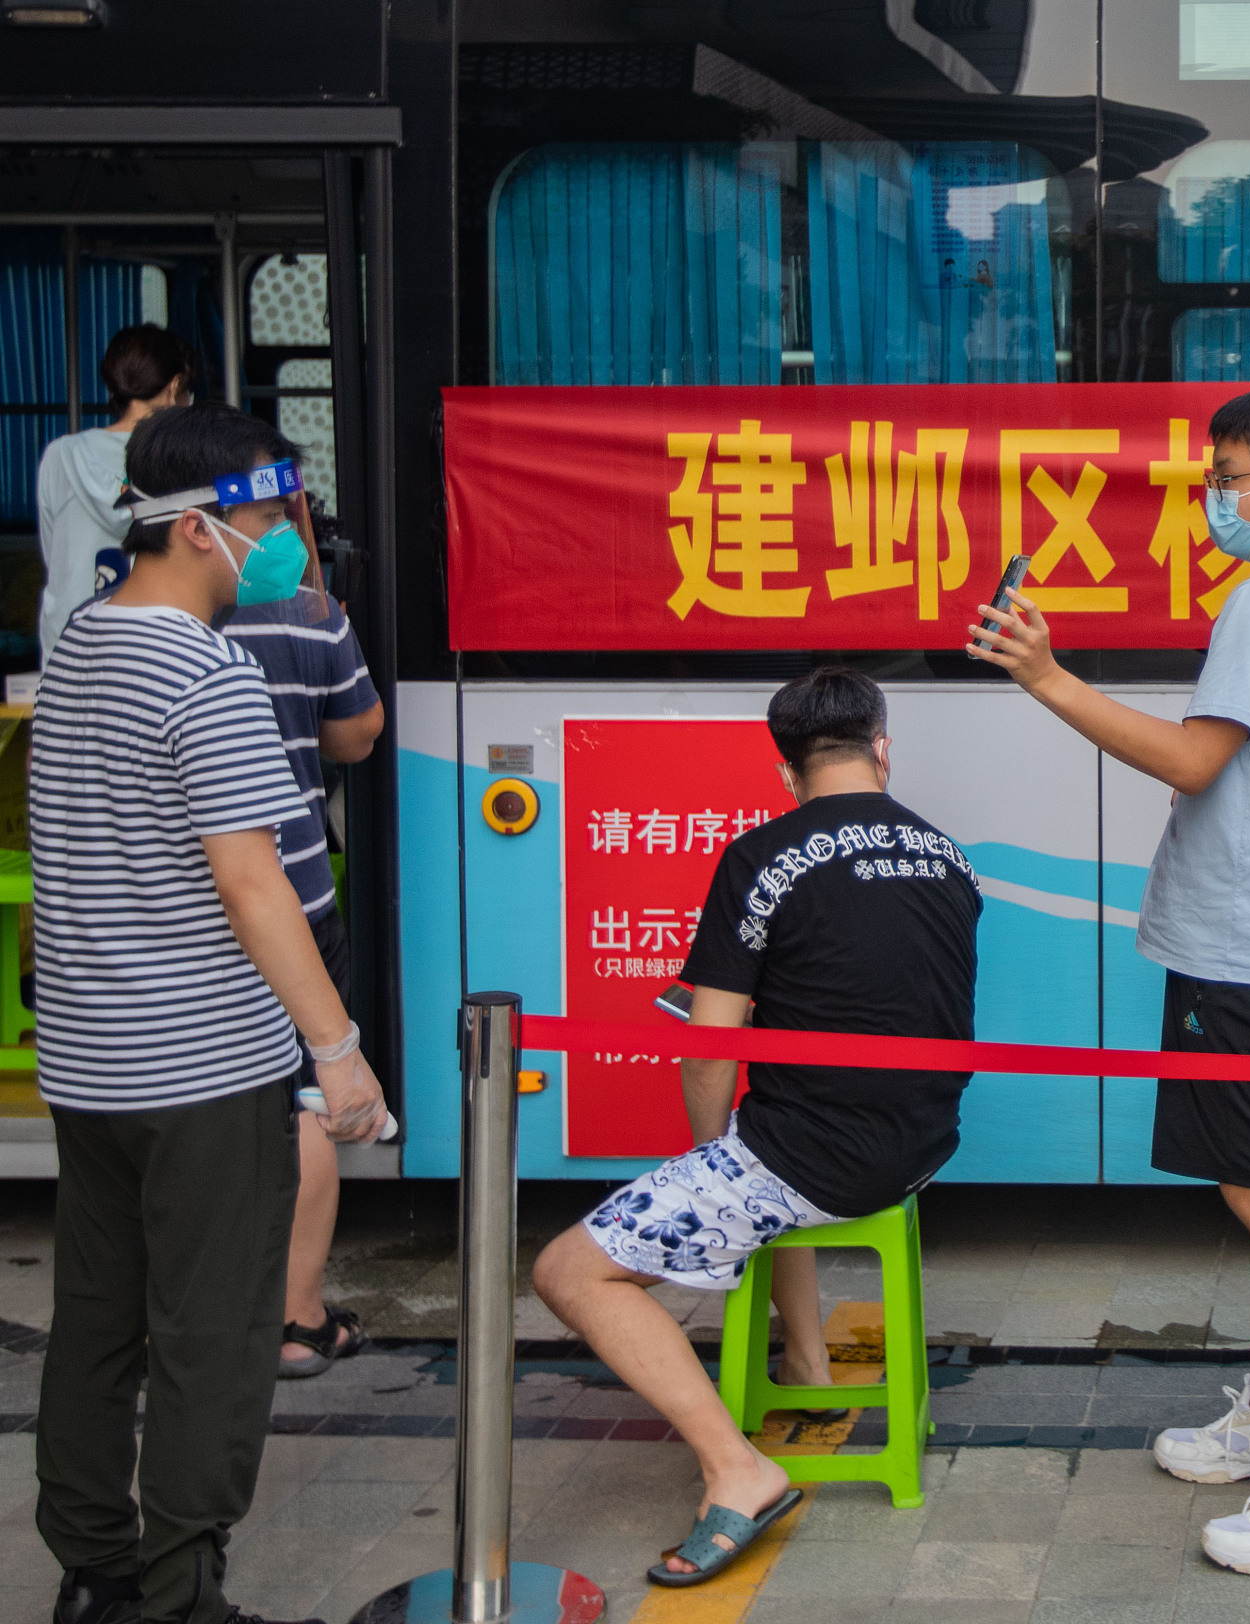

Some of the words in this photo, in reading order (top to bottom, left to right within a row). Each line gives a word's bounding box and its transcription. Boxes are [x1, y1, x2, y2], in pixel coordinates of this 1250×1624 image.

[588, 808, 788, 854] 请有序
[748, 824, 896, 917] CHROME
